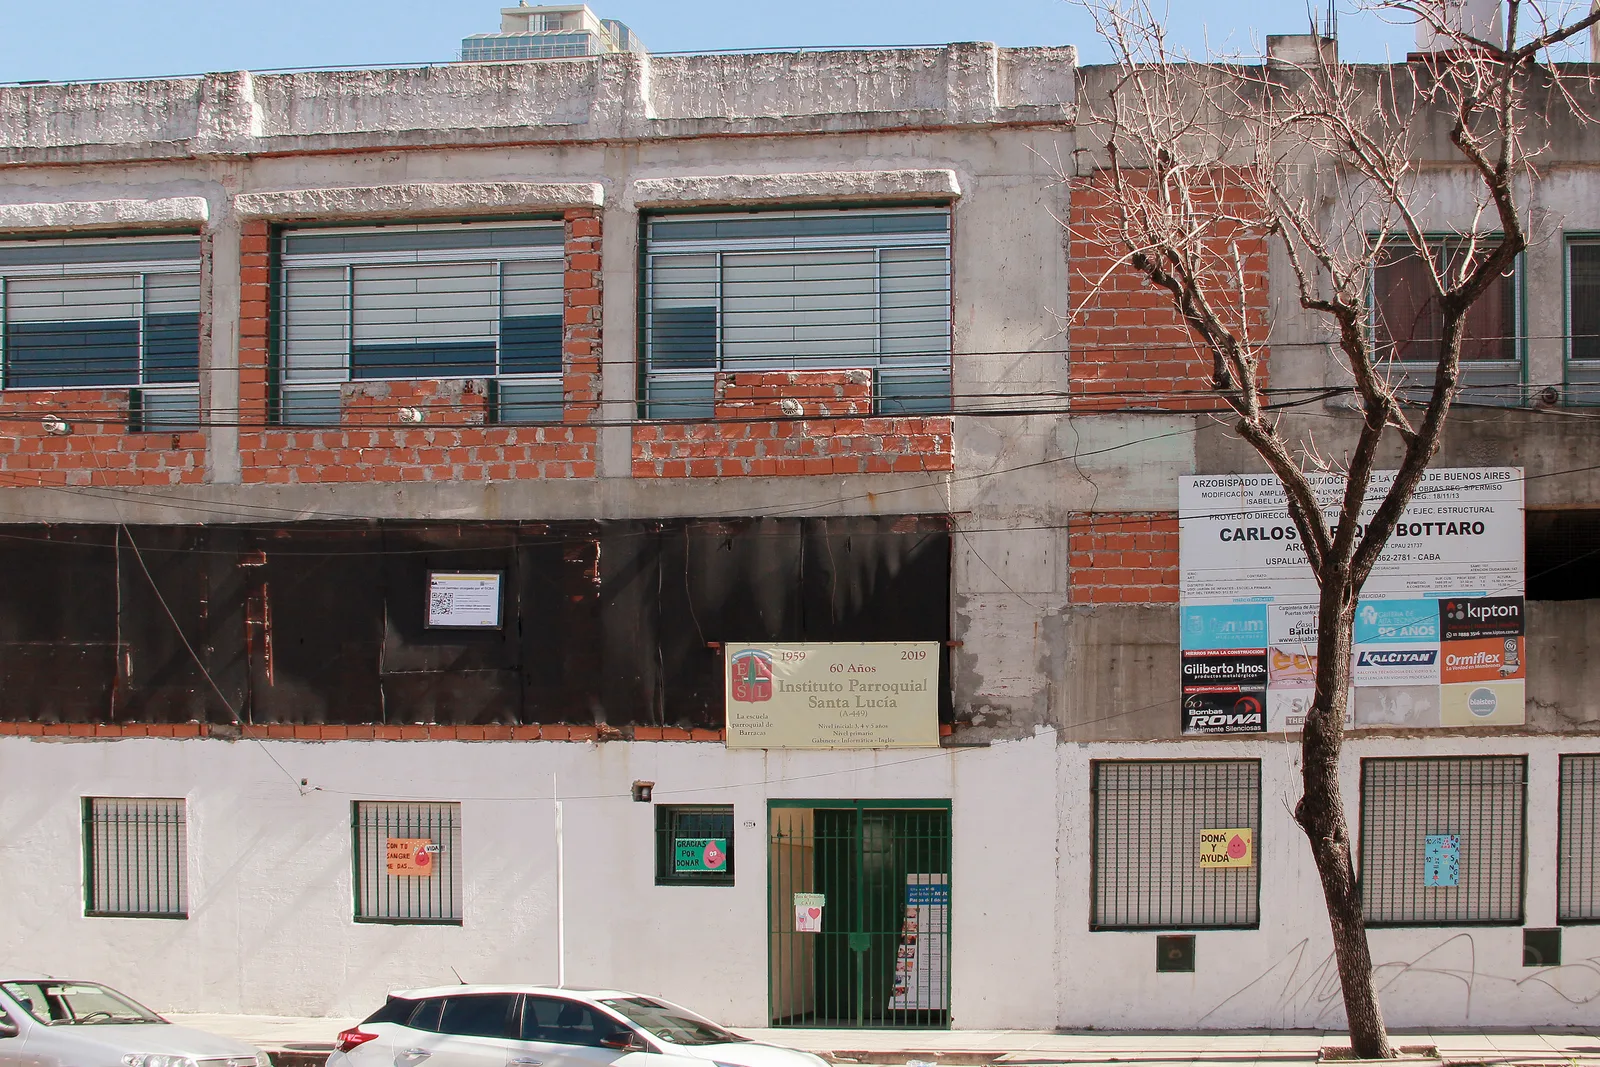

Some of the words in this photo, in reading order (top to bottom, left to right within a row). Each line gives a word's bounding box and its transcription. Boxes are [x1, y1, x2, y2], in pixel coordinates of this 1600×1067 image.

[1193, 479, 1258, 488] ARZOBISPADO
[1260, 479, 1273, 487] DE
[1429, 473, 1442, 481] DE
[1443, 472, 1482, 481] BUENOS
[1483, 471, 1511, 480] AIRES
[1418, 485, 1444, 493] OBRAS
[1433, 492, 1460, 500] 18/11/13
[1209, 511, 1253, 520] PROYECTO
[1254, 511, 1291, 520] DIRECCIO
[1413, 507, 1435, 515] EJEC.
[1437, 506, 1495, 514] ESTRUCTURAL
[1219, 526, 1297, 542] CARLOS
[1396, 521, 1485, 537] BOTTARO
[1377, 553, 1410, 562] 362-2781
[1417, 553, 1441, 561] CABA
[1467, 602, 1519, 621] kipton
[1295, 620, 1313, 629] Casa
[1400, 625, 1436, 636] AÑOS
[781, 651, 806, 662] 1959
[900, 650, 927, 661] 2019
[1362, 651, 1430, 664] KALCIYAN
[1445, 651, 1501, 666] Ormiflex
[736, 663, 747, 676] E
[829, 663, 844, 674] 60
[847, 663, 877, 673] Años
[1184, 662, 1234, 675] Giliberto
[1236, 662, 1266, 673] Hnos.
[736, 685, 747, 698] S
[757, 685, 768, 698] L
[778, 679, 843, 693] Instituto
[848, 678, 928, 694] Parroquial
[808, 695, 850, 709] Santa
[855, 695, 898, 709] Lucía
[839, 710, 868, 718] (A-449)
[731, 721, 764, 729] parroquial
[1189, 713, 1262, 727] ROWA
[1189, 725, 1225, 733] Totalmente
[1225, 724, 1262, 732] Silenciosas
[1201, 832, 1227, 843] DONÁ
[676, 840, 707, 848] GRACIAS
[1211, 843, 1217, 852] Y
[1200, 851, 1230, 862] AYUDÁ
[676, 859, 700, 867] DONAR
